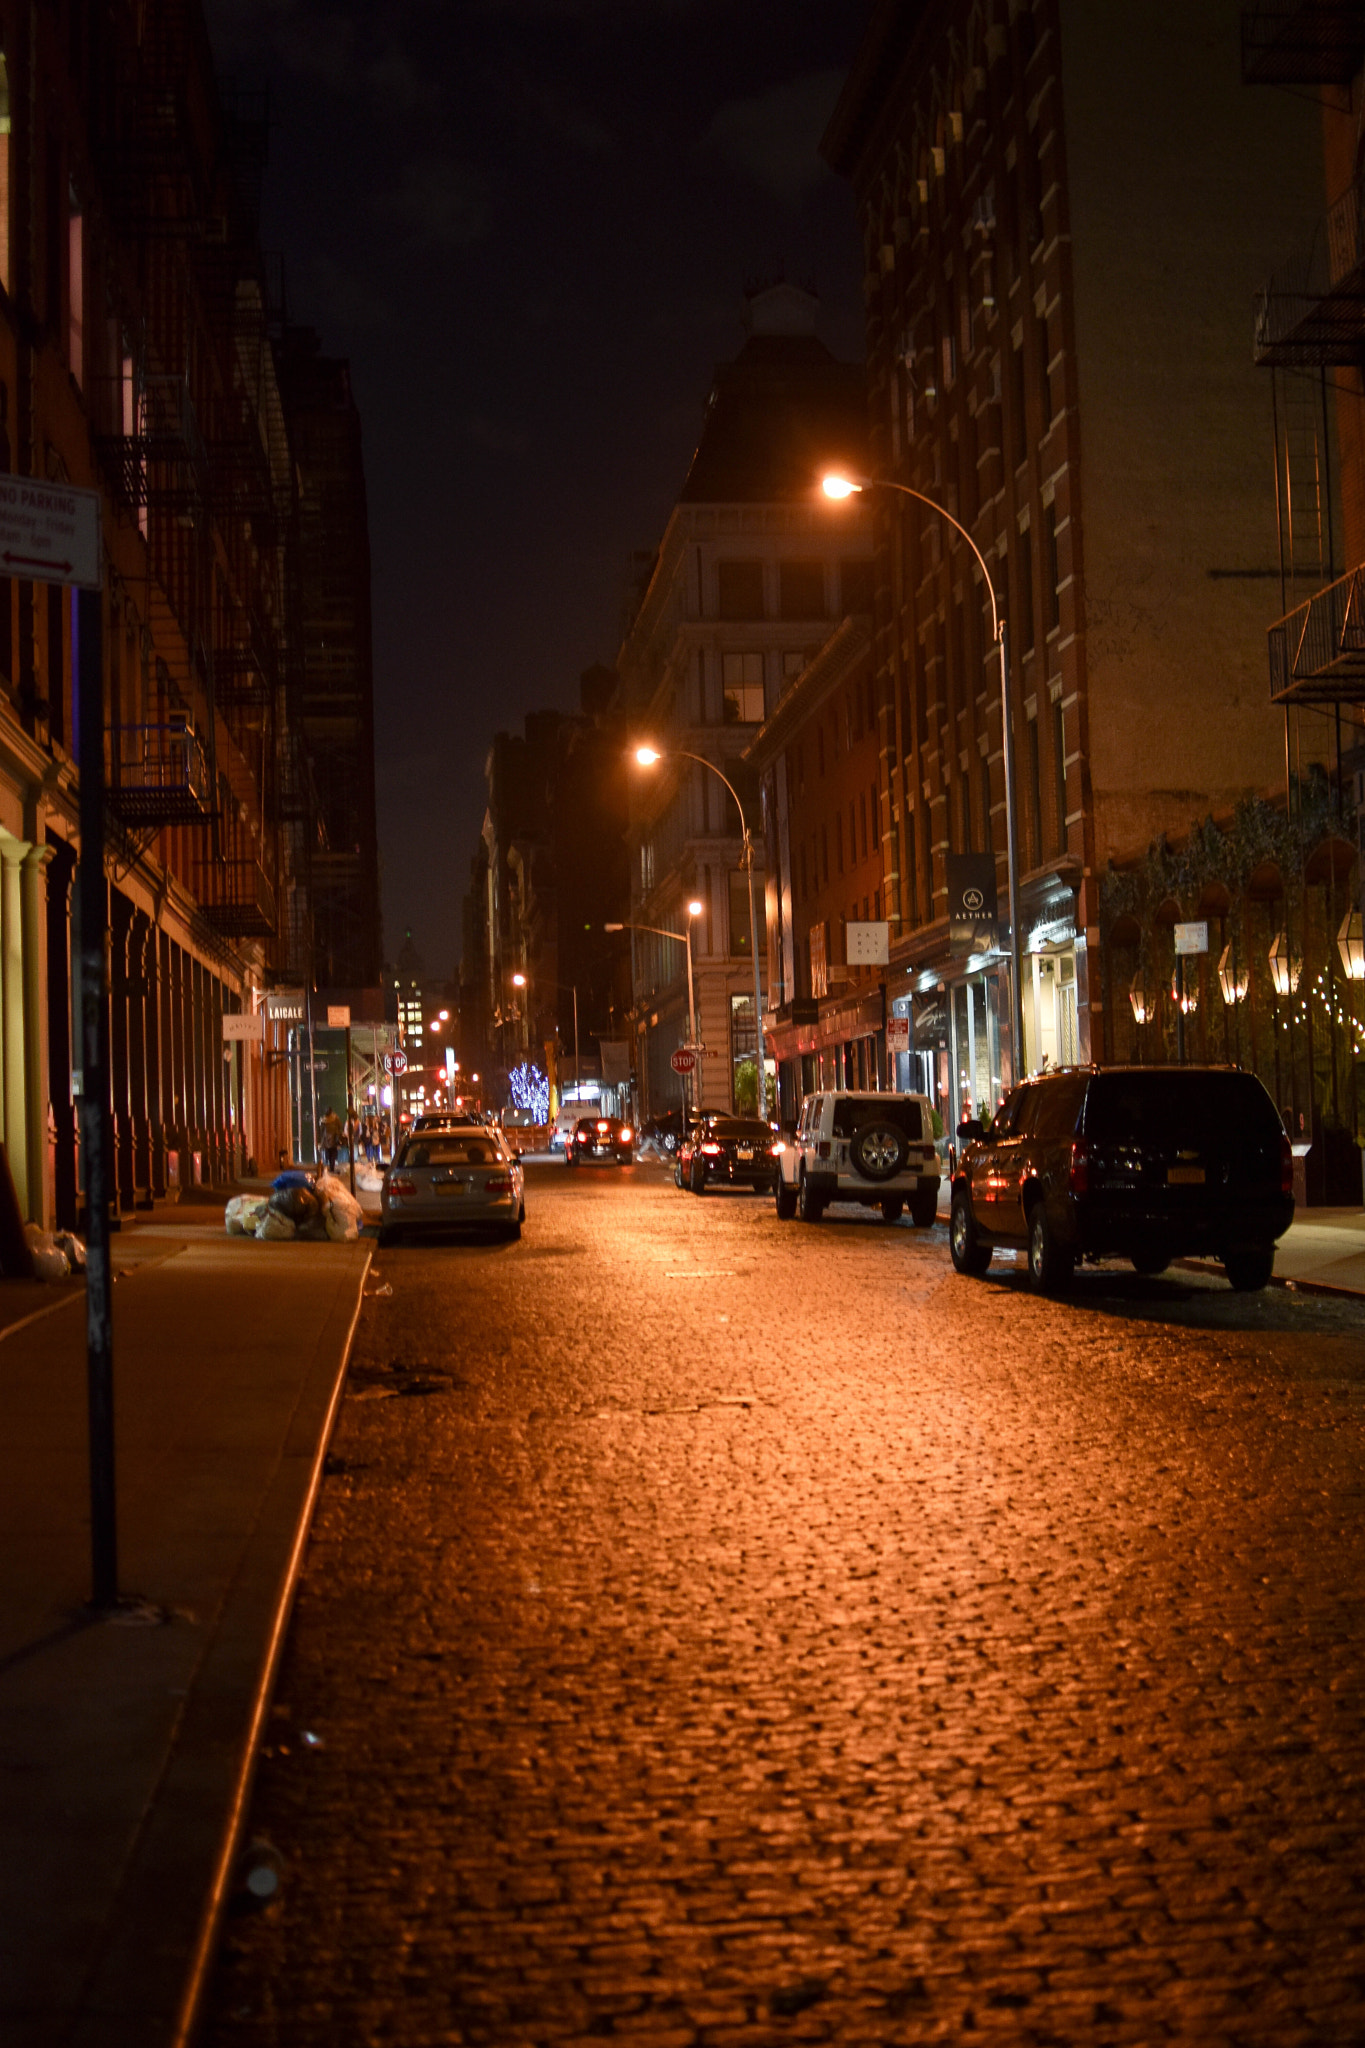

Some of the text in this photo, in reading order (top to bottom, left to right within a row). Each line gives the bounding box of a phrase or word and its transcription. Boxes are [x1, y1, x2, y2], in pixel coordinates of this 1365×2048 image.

[0, 486, 76, 515] NO PARKING
[955, 911, 993, 920] AETHER
[269, 1006, 303, 1020] LAICALE
[386, 1056, 406, 1069] SOP
[672, 1056, 694, 1067] STOP
